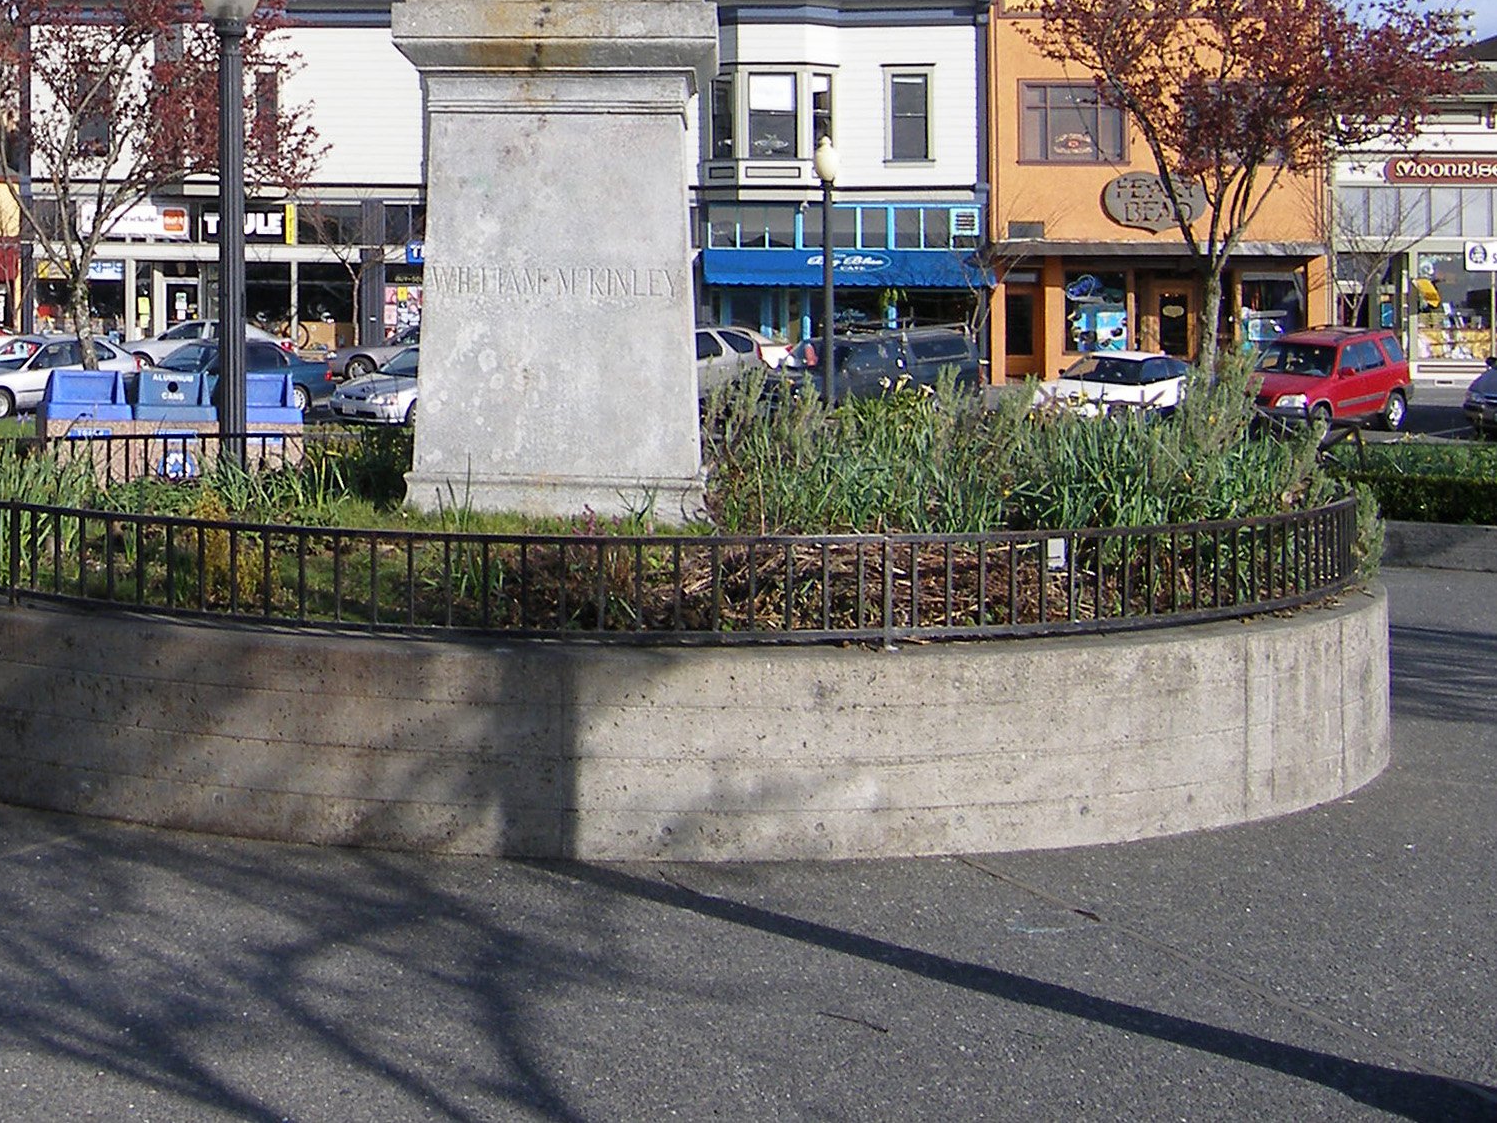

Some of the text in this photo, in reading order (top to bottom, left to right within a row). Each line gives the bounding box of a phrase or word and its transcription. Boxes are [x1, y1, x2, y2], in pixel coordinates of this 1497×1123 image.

[203, 212, 282, 235] TULE
[152, 373, 194, 382] ALUMINUM
[161, 391, 185, 400] CANS
